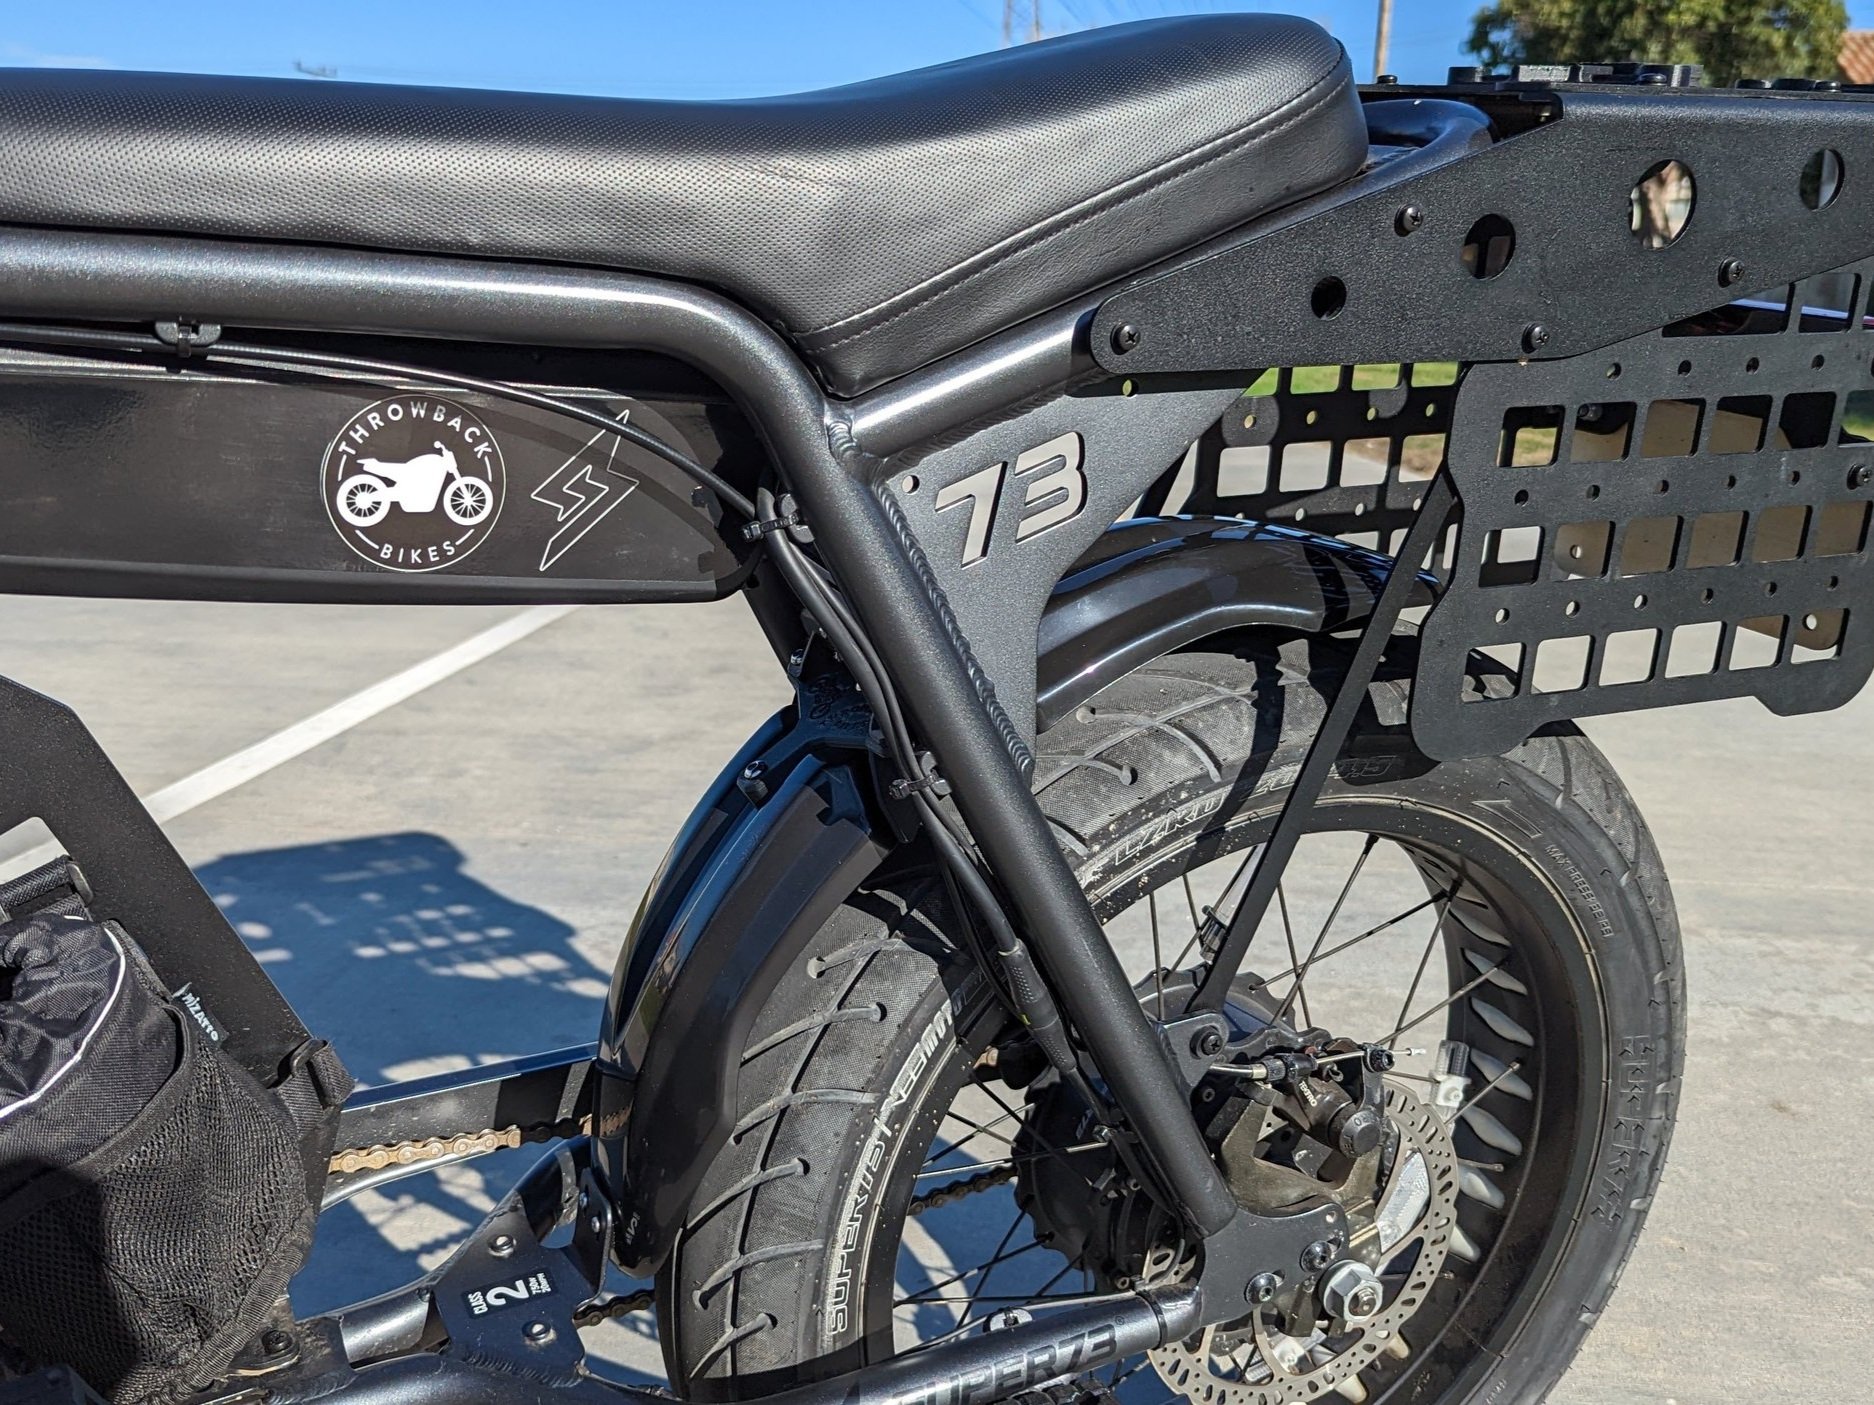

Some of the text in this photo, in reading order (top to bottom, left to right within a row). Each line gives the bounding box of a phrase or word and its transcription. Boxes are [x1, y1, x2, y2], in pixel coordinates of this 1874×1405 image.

[338, 400, 494, 459] THROWBACK
[935, 431, 1088, 570] 73
[379, 540, 456, 565] BIKES
[467, 1291, 489, 1315] CLASS
[486, 1279, 530, 1306] 2
